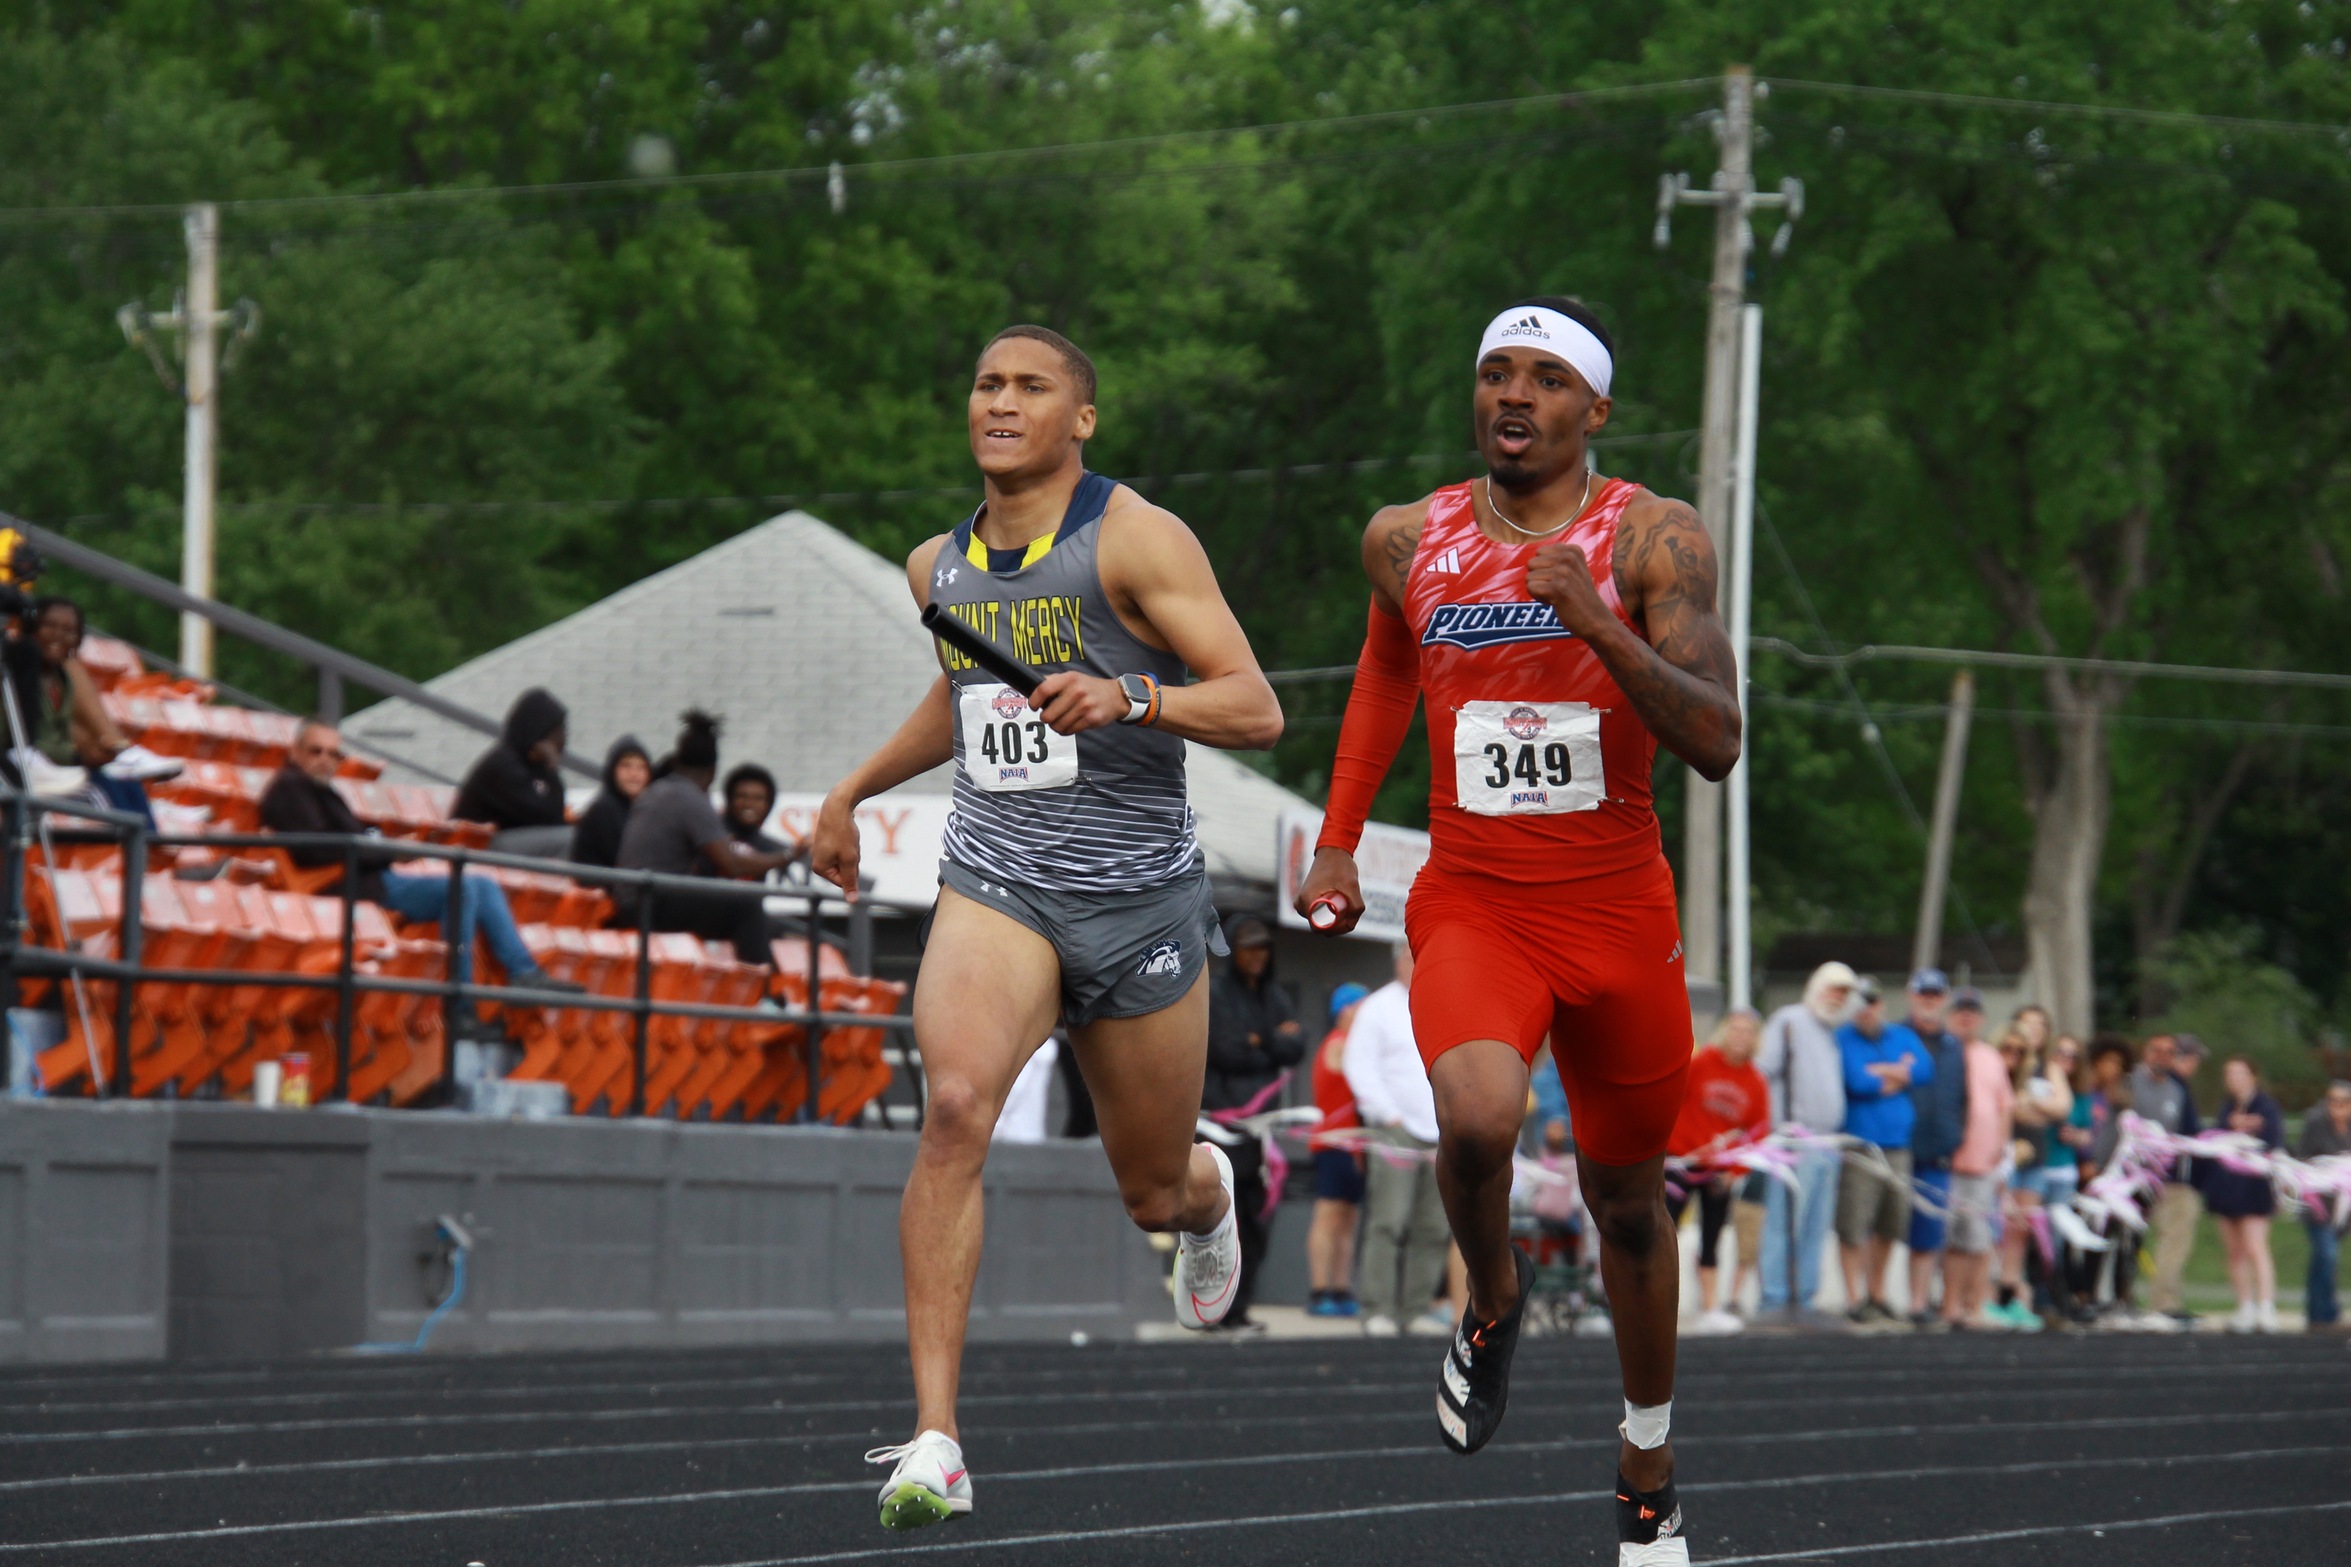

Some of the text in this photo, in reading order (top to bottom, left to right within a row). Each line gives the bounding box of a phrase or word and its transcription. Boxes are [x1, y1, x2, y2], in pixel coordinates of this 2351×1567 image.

[1501, 325, 1551, 339] adidas
[1010, 596, 1085, 665] MERCY
[981, 721, 1049, 765] 403
[1000, 766, 1029, 780] NAIA
[1484, 742, 1572, 788] 349
[1511, 792, 1547, 805] NAIA
